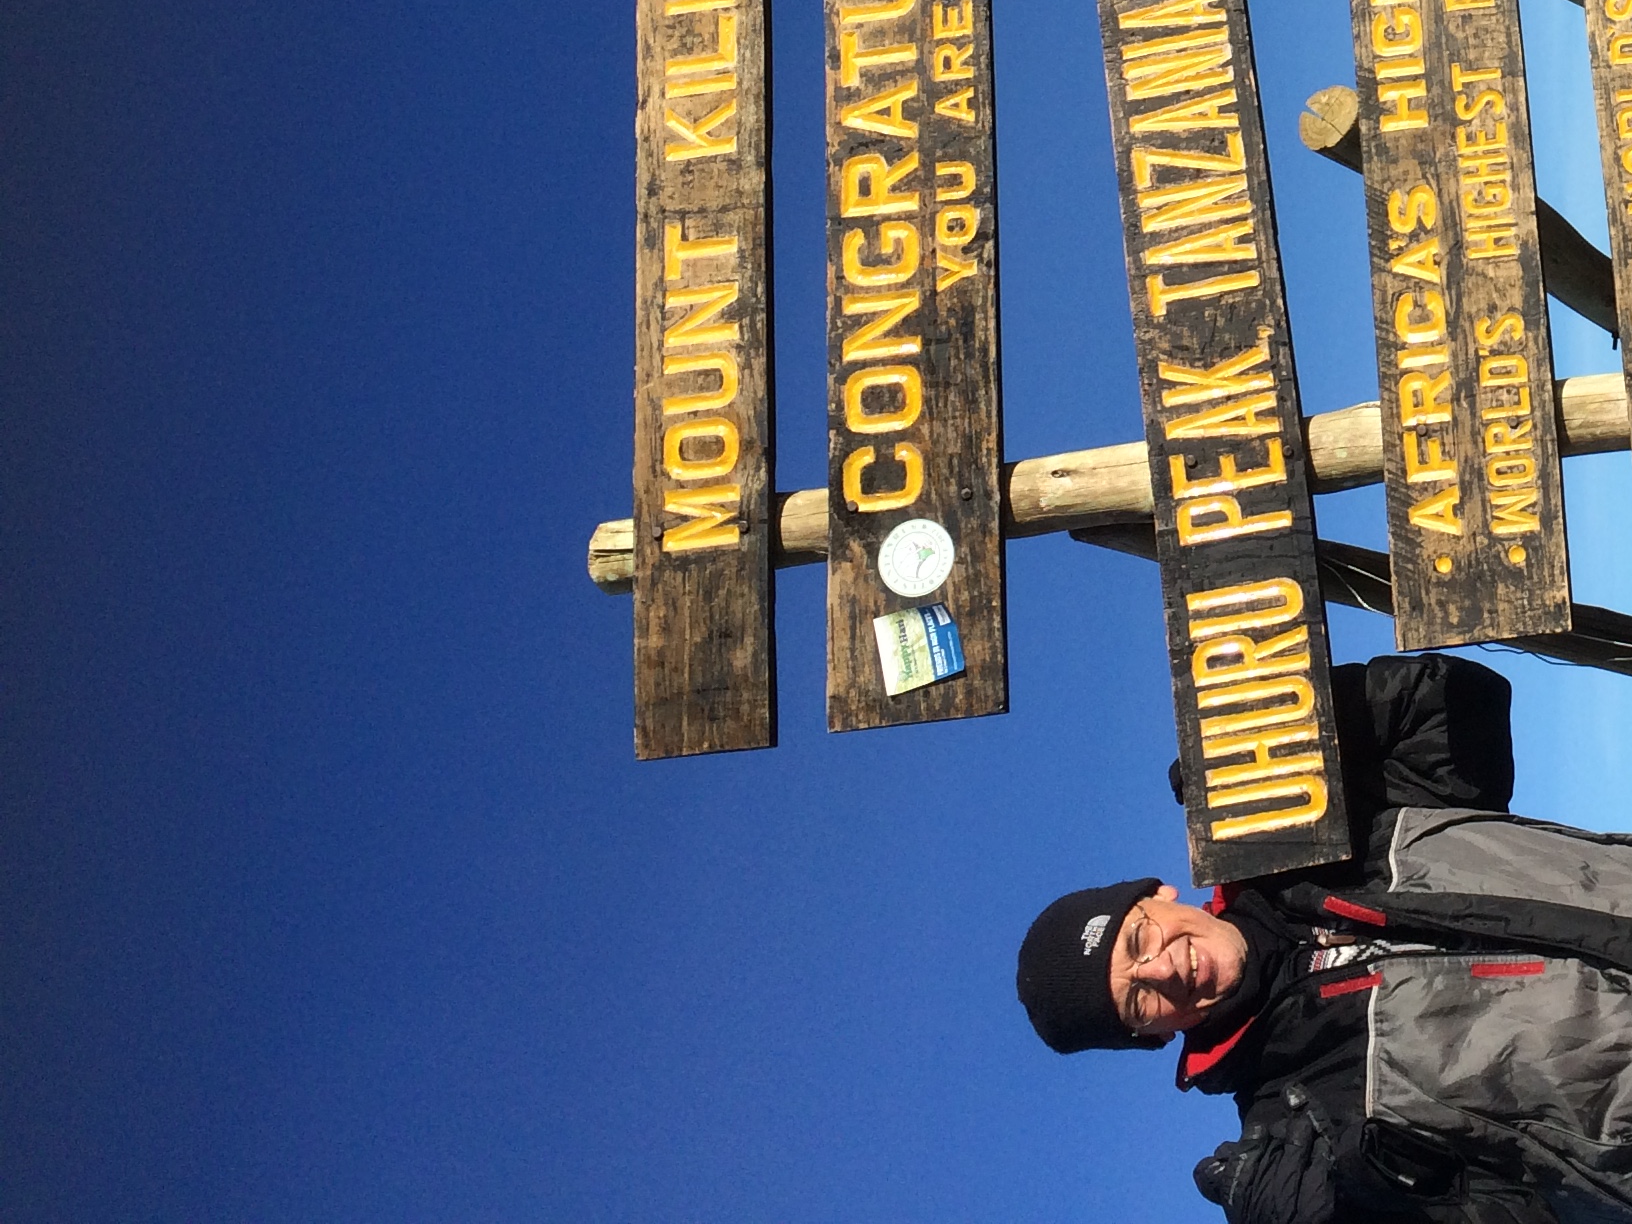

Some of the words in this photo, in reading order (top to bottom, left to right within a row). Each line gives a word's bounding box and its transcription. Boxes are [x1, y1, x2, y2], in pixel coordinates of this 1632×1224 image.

[932, 0, 975, 123] ARE
[1450, 63, 1519, 259] HIGHEST
[935, 162, 978, 291] YOU
[662, 224, 740, 552] MOUNT
[1387, 185, 1463, 535] AFRICA'S
[1475, 313, 1541, 534] WORLD'S
[1185, 578, 1328, 840] UHURU
[1081, 926, 1092, 940] THE
